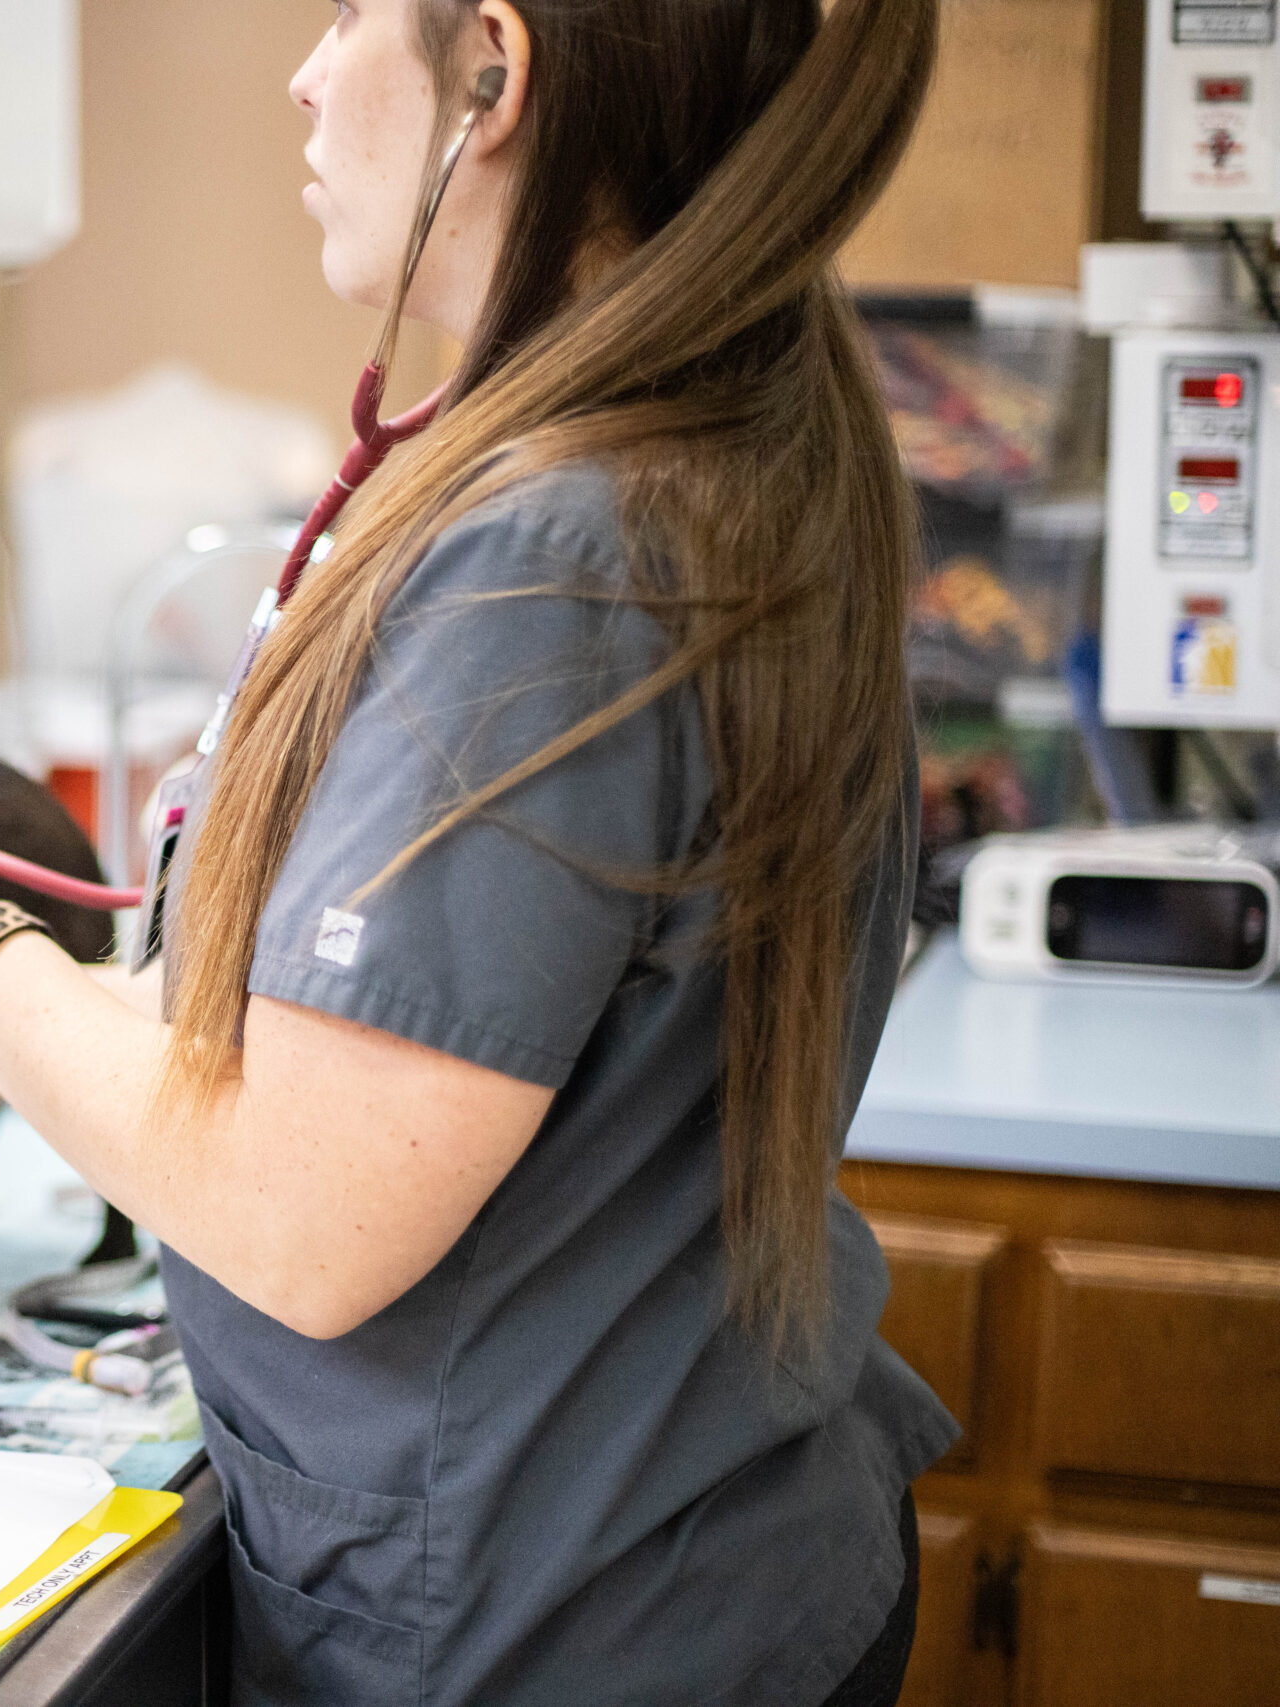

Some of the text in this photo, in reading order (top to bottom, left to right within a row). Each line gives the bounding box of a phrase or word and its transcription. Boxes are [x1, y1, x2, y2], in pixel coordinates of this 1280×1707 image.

[13, 1550, 101, 1608] TECH ONLY APPT
